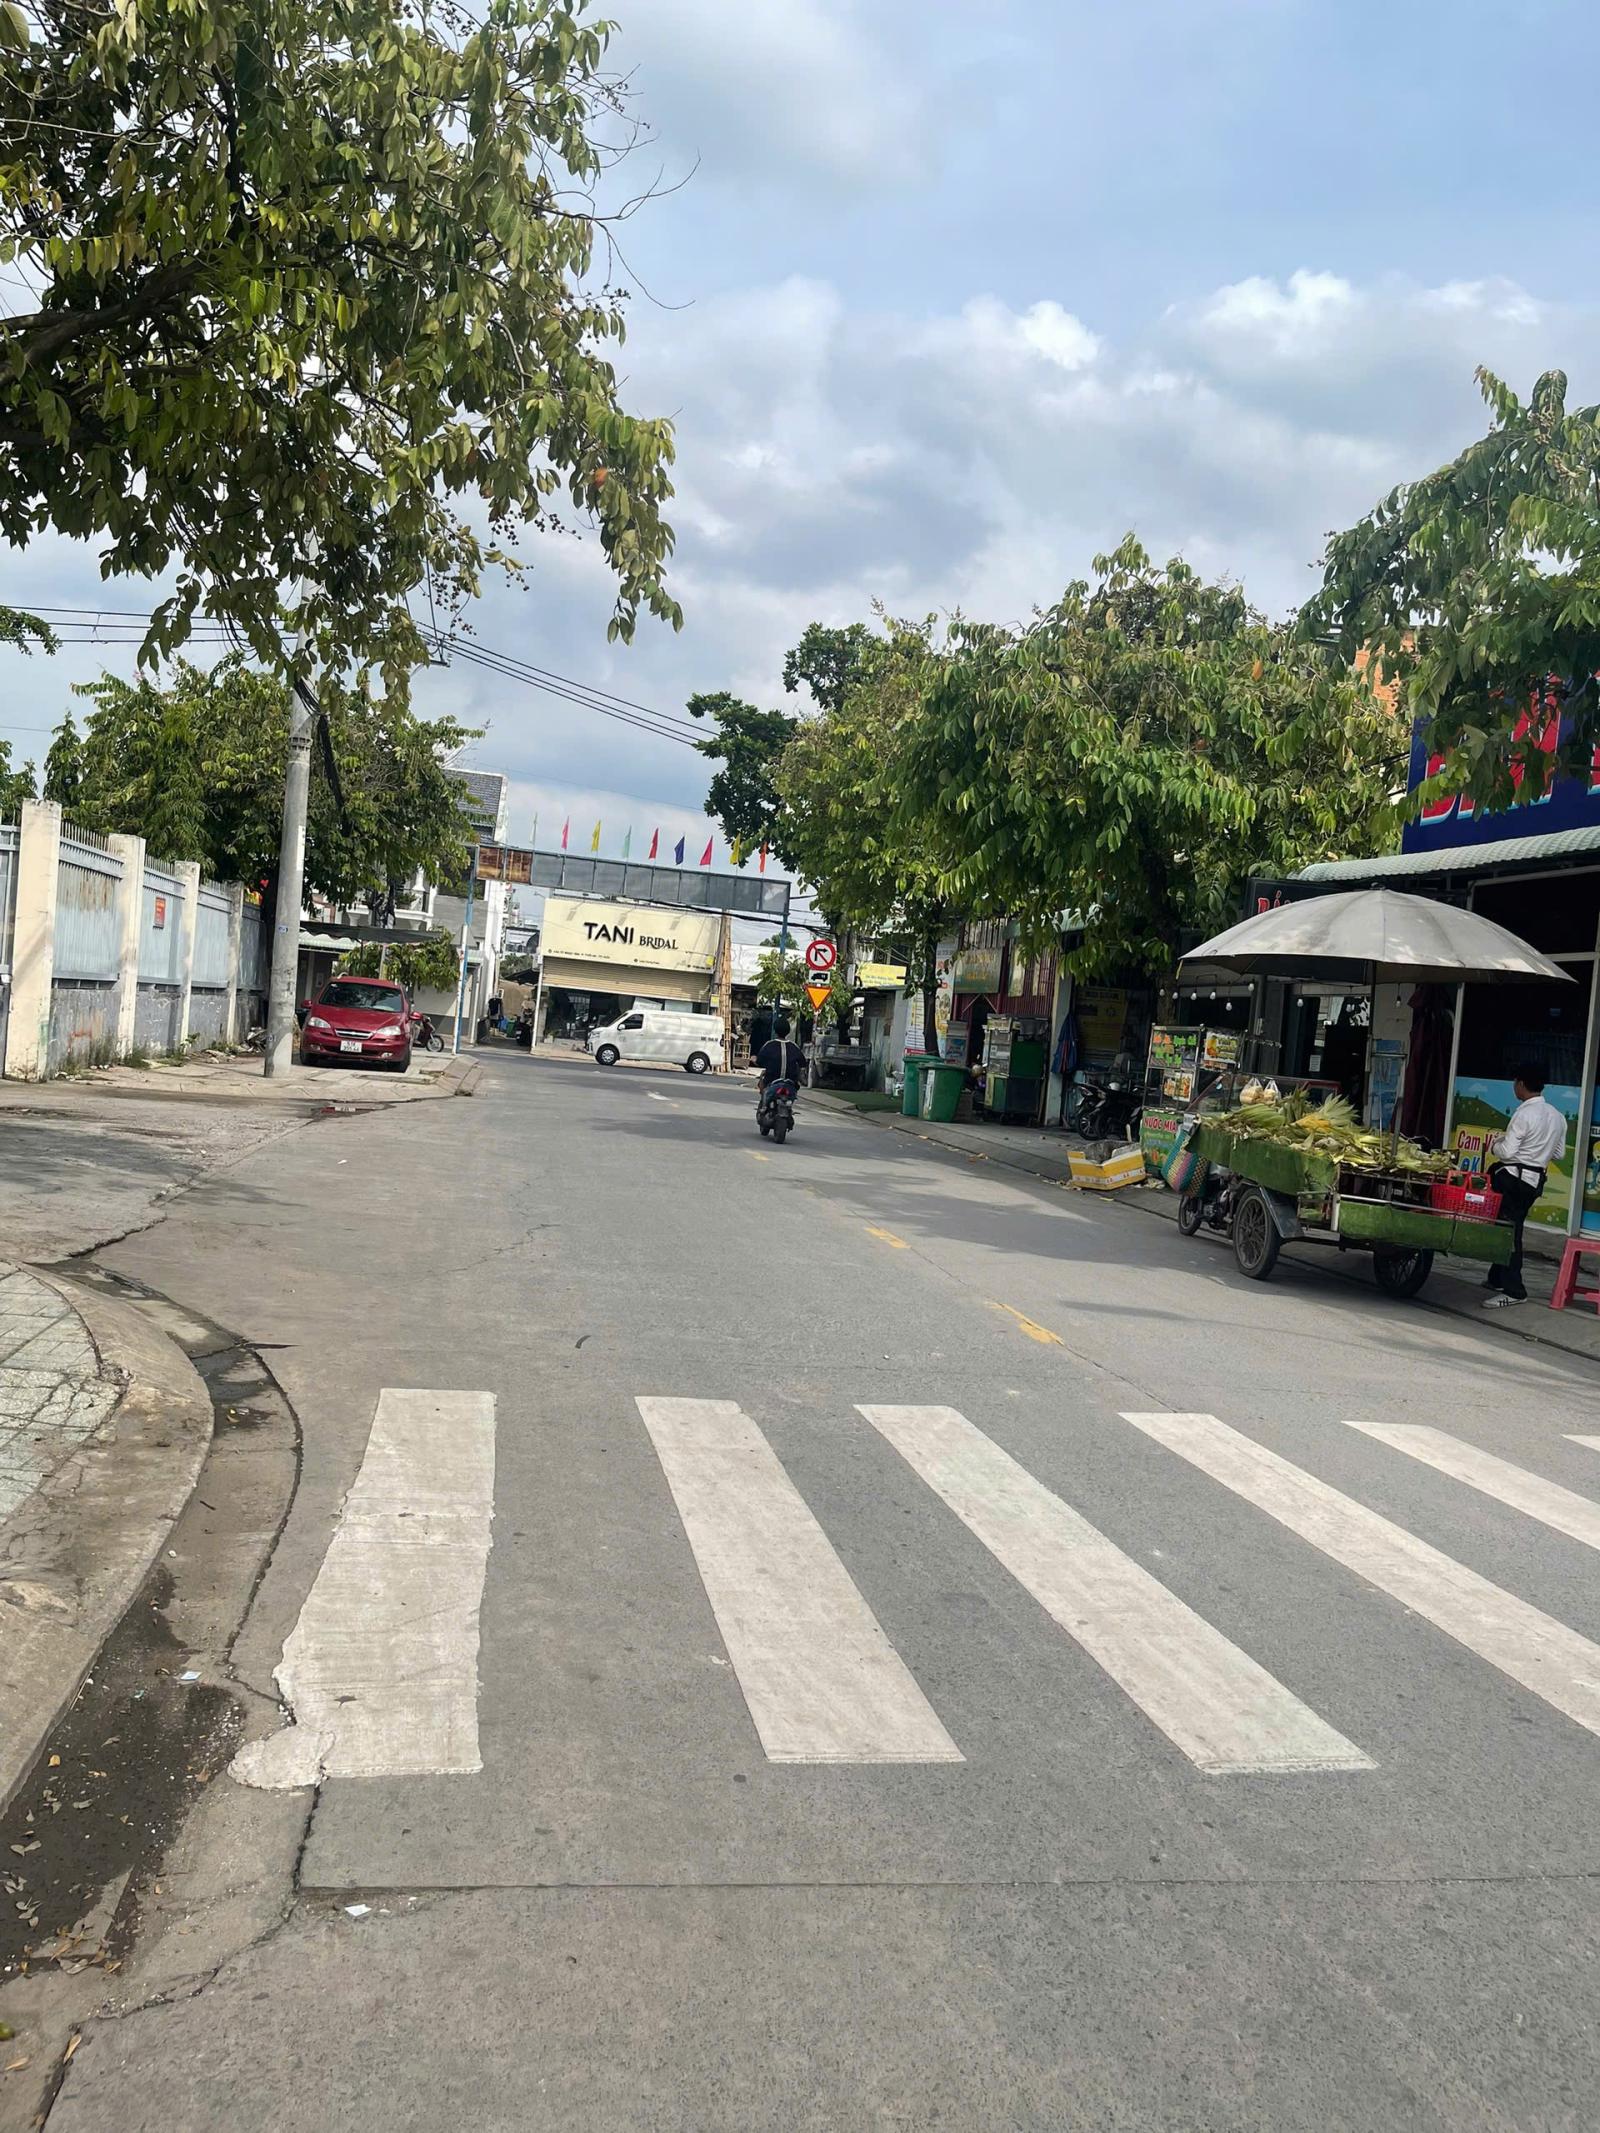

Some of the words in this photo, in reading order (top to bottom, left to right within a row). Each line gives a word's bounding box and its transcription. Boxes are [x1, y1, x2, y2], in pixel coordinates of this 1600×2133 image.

[584, 922, 635, 945] TANI
[639, 935, 679, 950] BRIDAL
[1457, 1131, 1480, 1151] Cam
